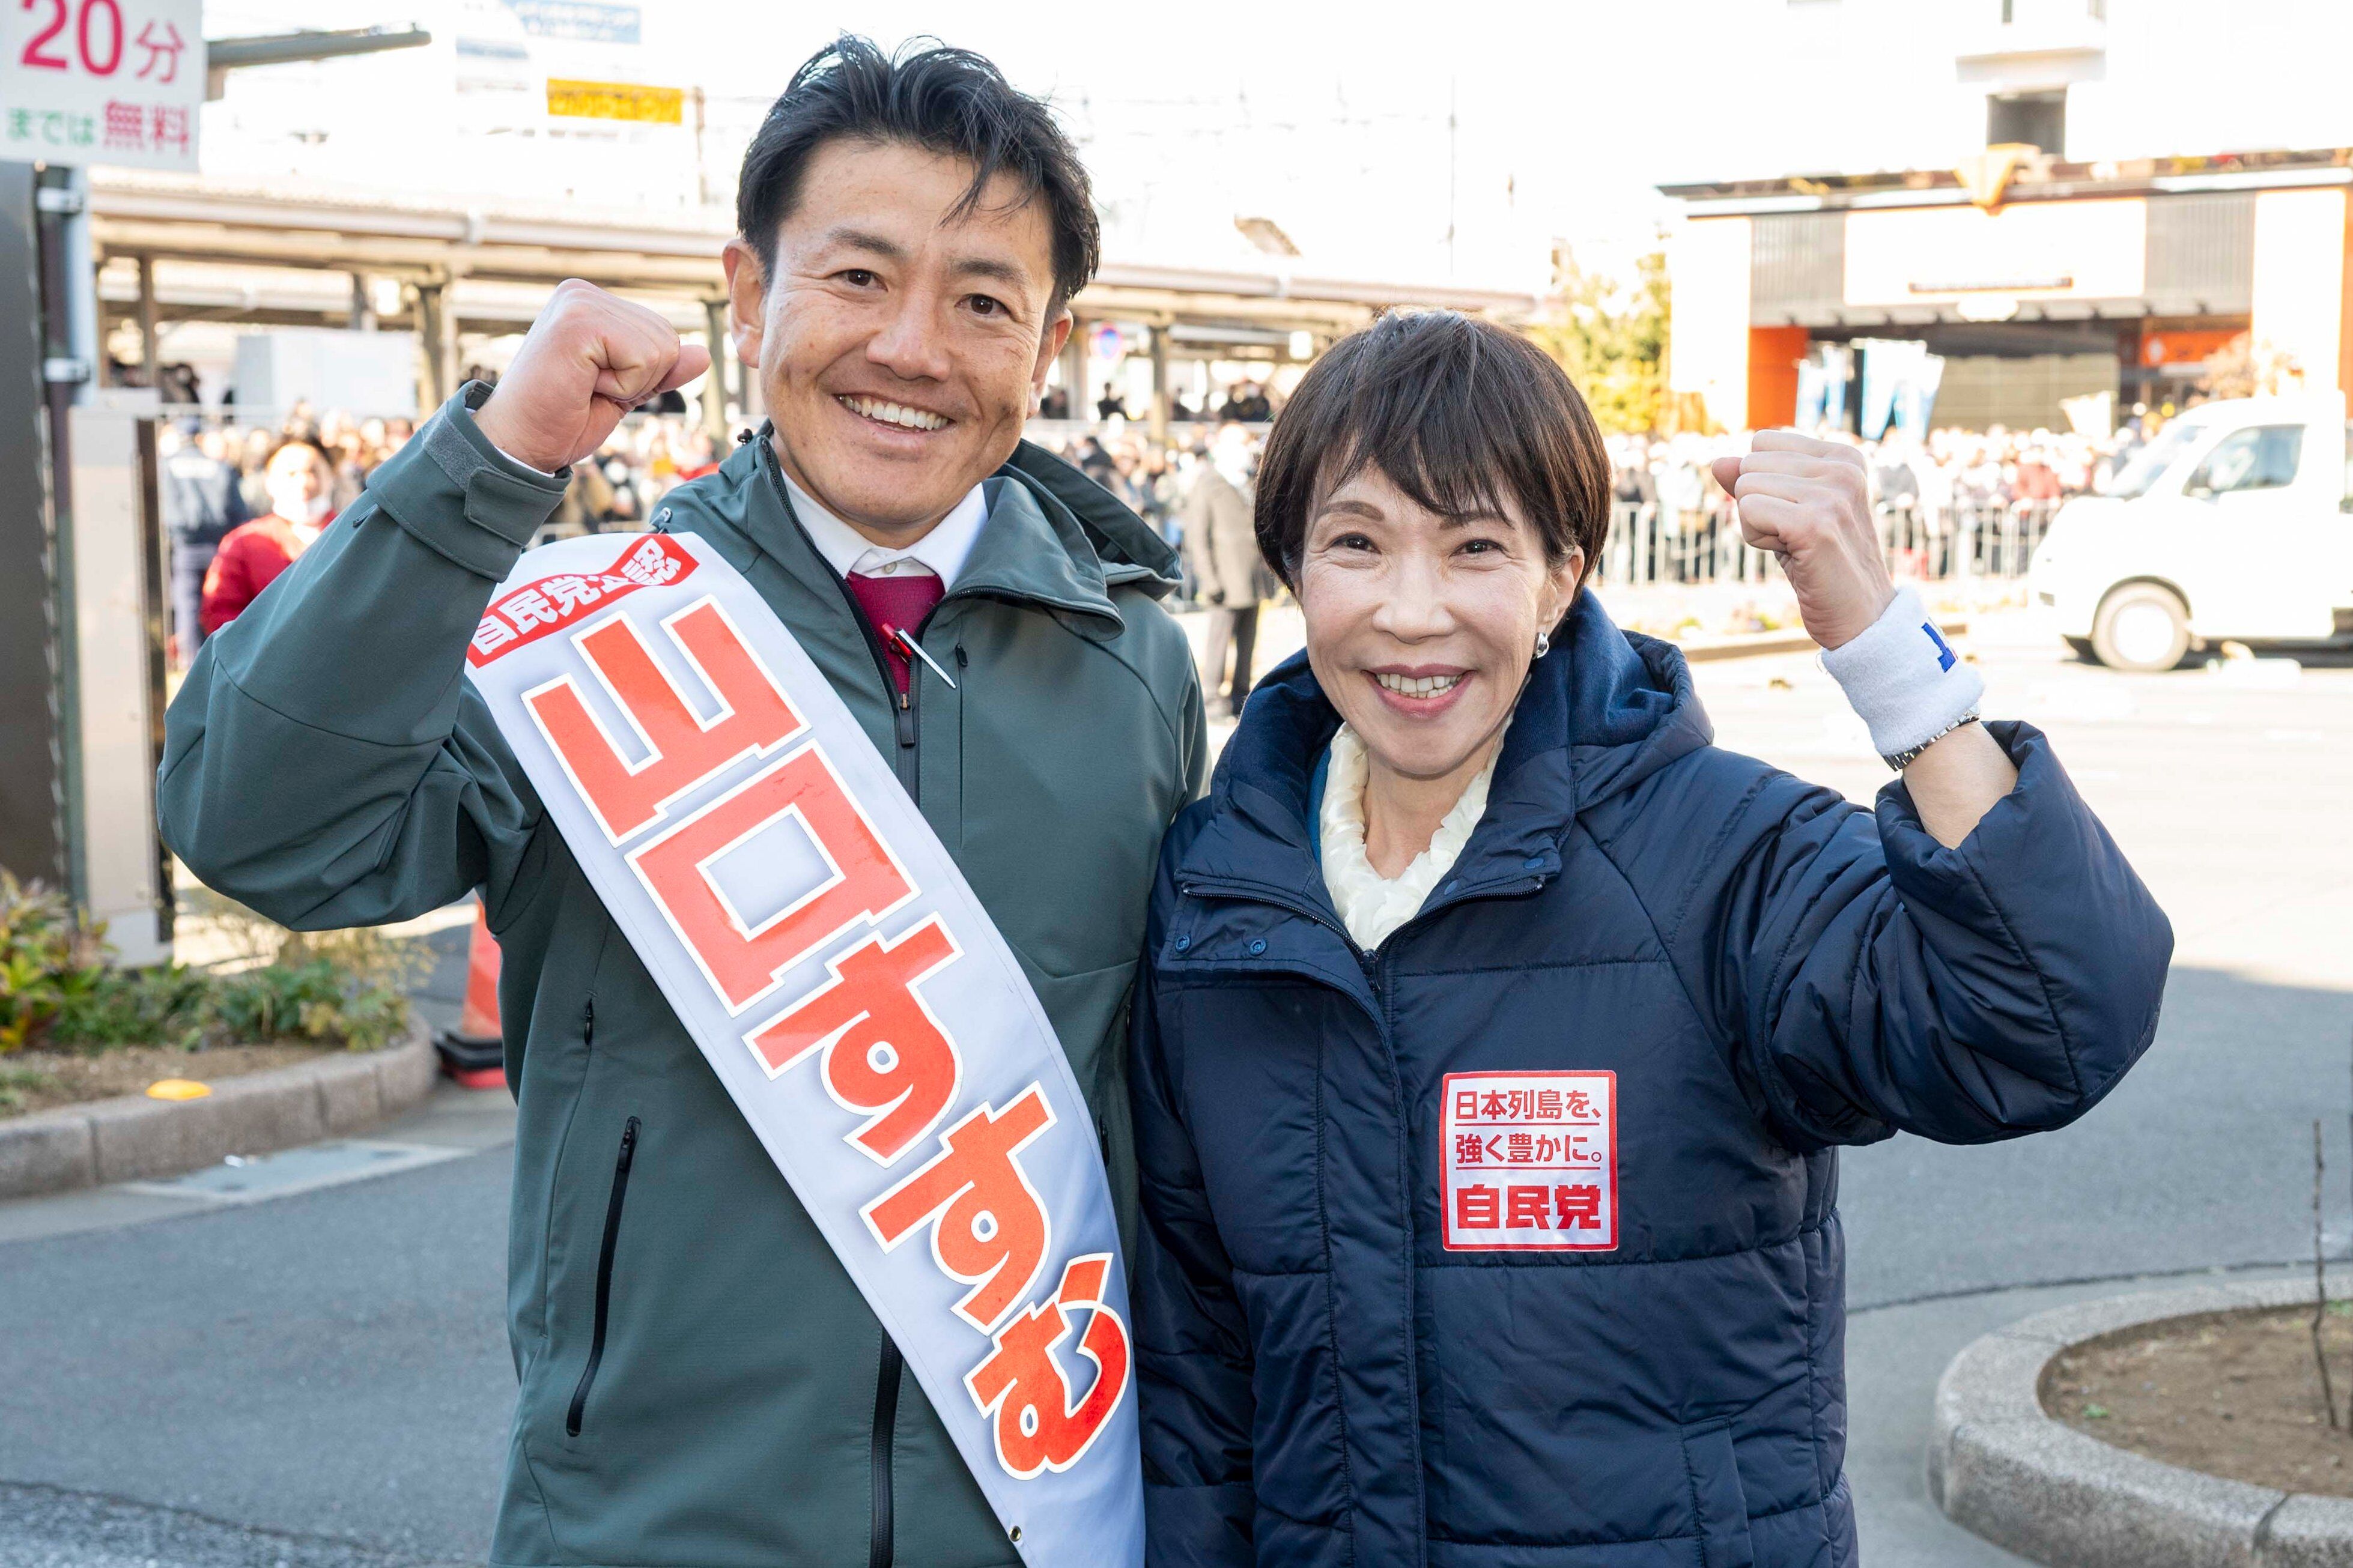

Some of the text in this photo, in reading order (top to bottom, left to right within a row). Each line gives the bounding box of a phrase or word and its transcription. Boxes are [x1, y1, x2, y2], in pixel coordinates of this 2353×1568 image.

[22, 0, 185, 83] 20分
[7, 100, 189, 155] までは無料
[470, 537, 682, 656] 自民党公認
[523, 595, 1129, 1479] 山口すすむ
[1456, 1089, 1602, 1120] 日本列島を、
[1456, 1133, 1602, 1164] 強く豊かに。
[1456, 1184, 1602, 1230] 自民党
